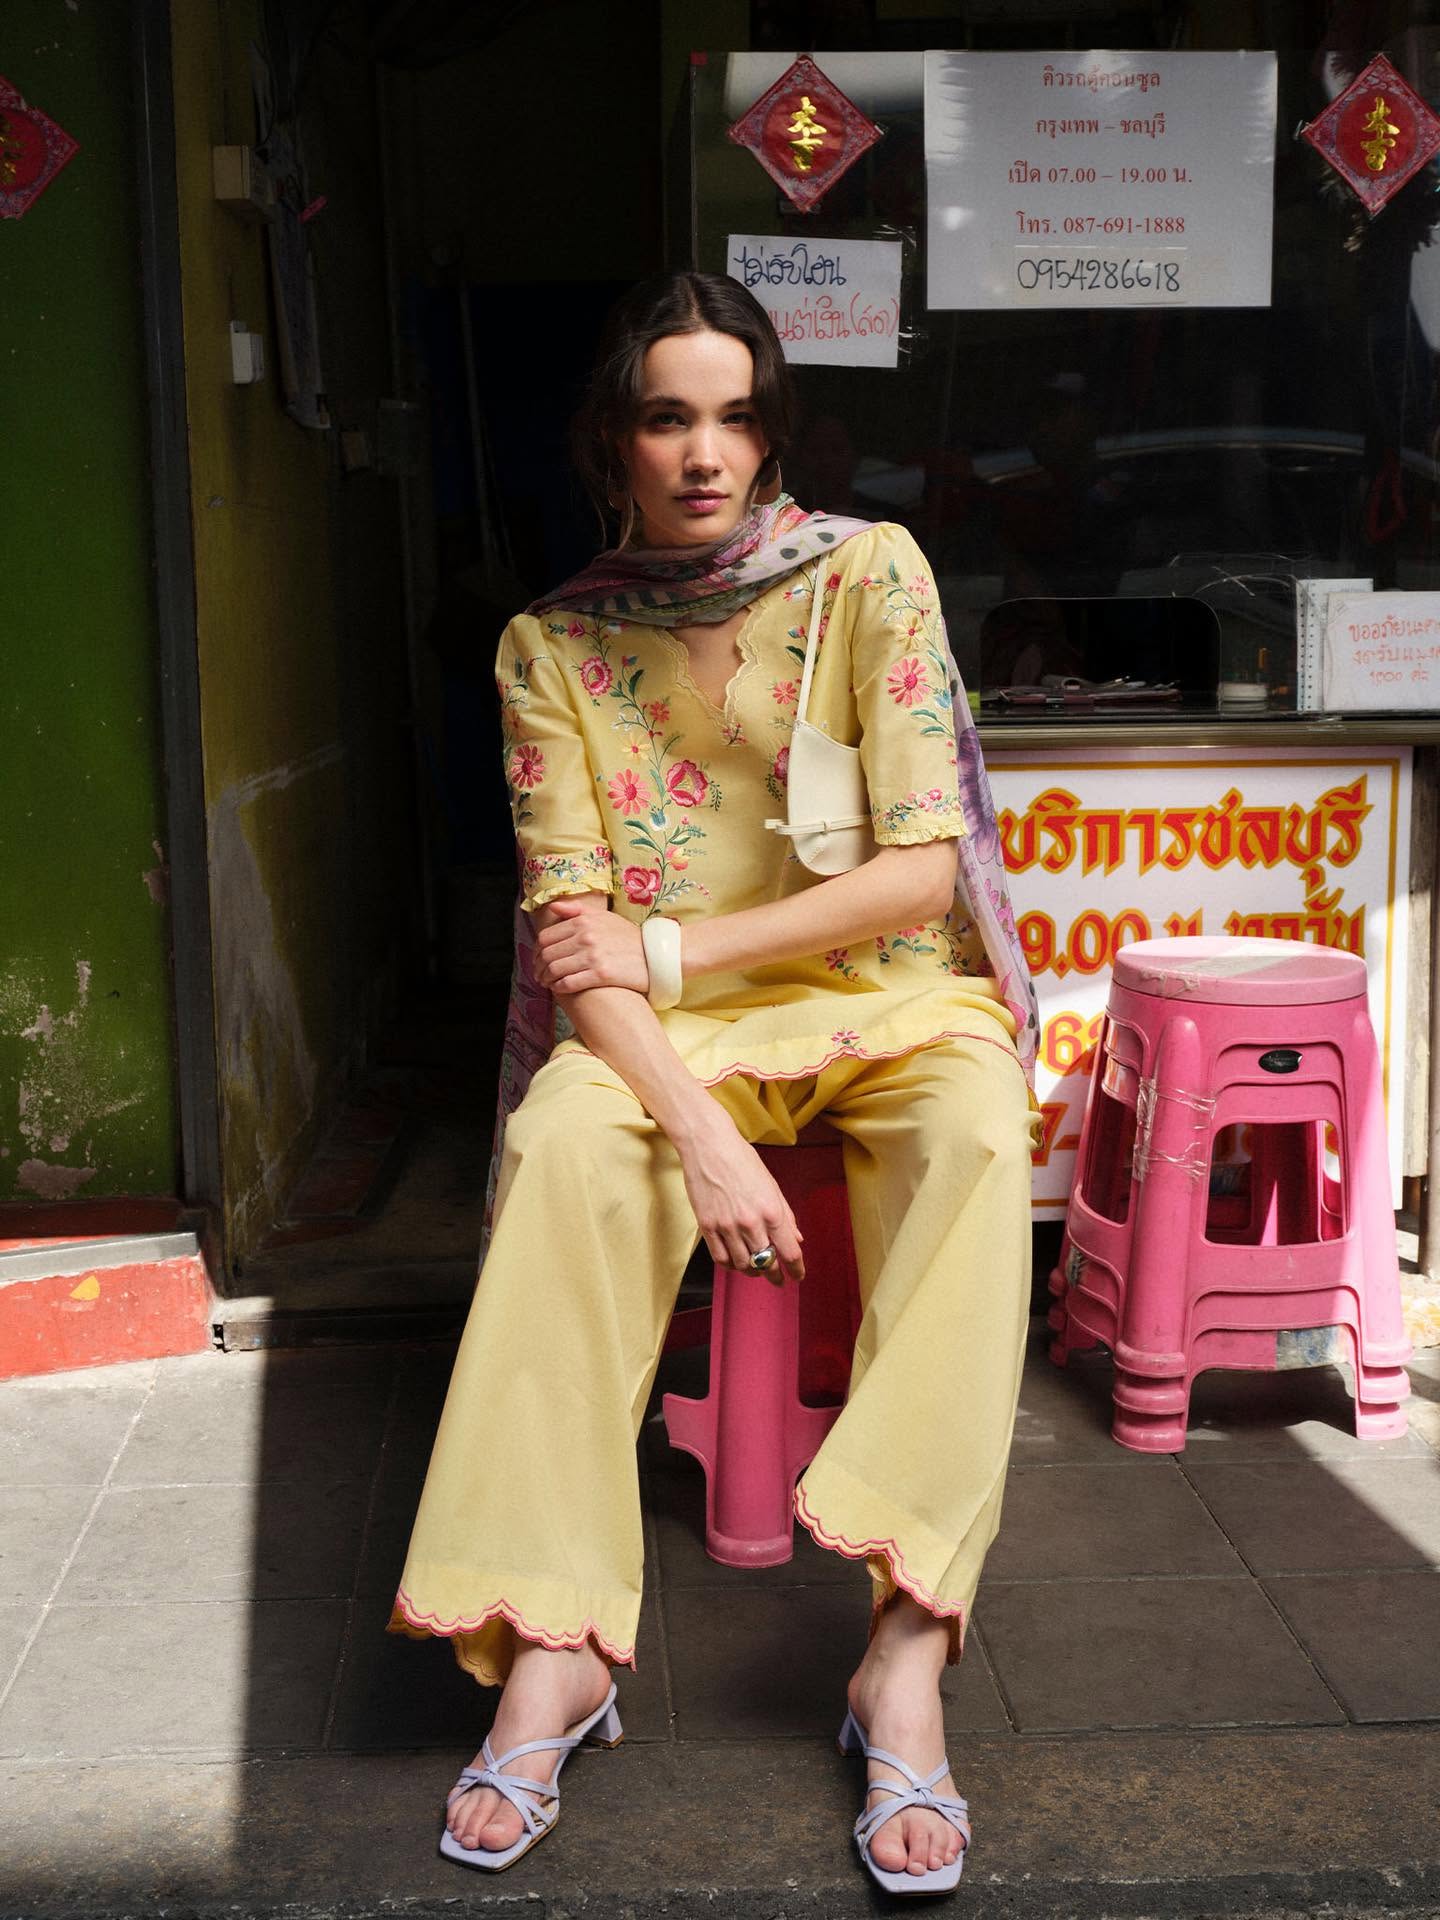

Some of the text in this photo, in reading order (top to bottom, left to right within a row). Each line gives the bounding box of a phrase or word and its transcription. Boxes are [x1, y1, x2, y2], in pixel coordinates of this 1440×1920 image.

[1036, 118, 1099, 139] กรุงเทพ
[1120, 112, 1166, 139] ชลบุรี
[1008, 160, 1041, 184] เปิด
[1048, 167, 1096, 183] 07.00
[1120, 167, 1167, 183] 19.00
[1173, 167, 1192, 184] น.
[1015, 211, 1186, 234] โทร. 087-691-1888
[733, 243, 847, 287] ไม่รับโอน
[1017, 259, 1180, 292] 0954286618
[1000, 773, 1375, 893] บริการชลบุรี
